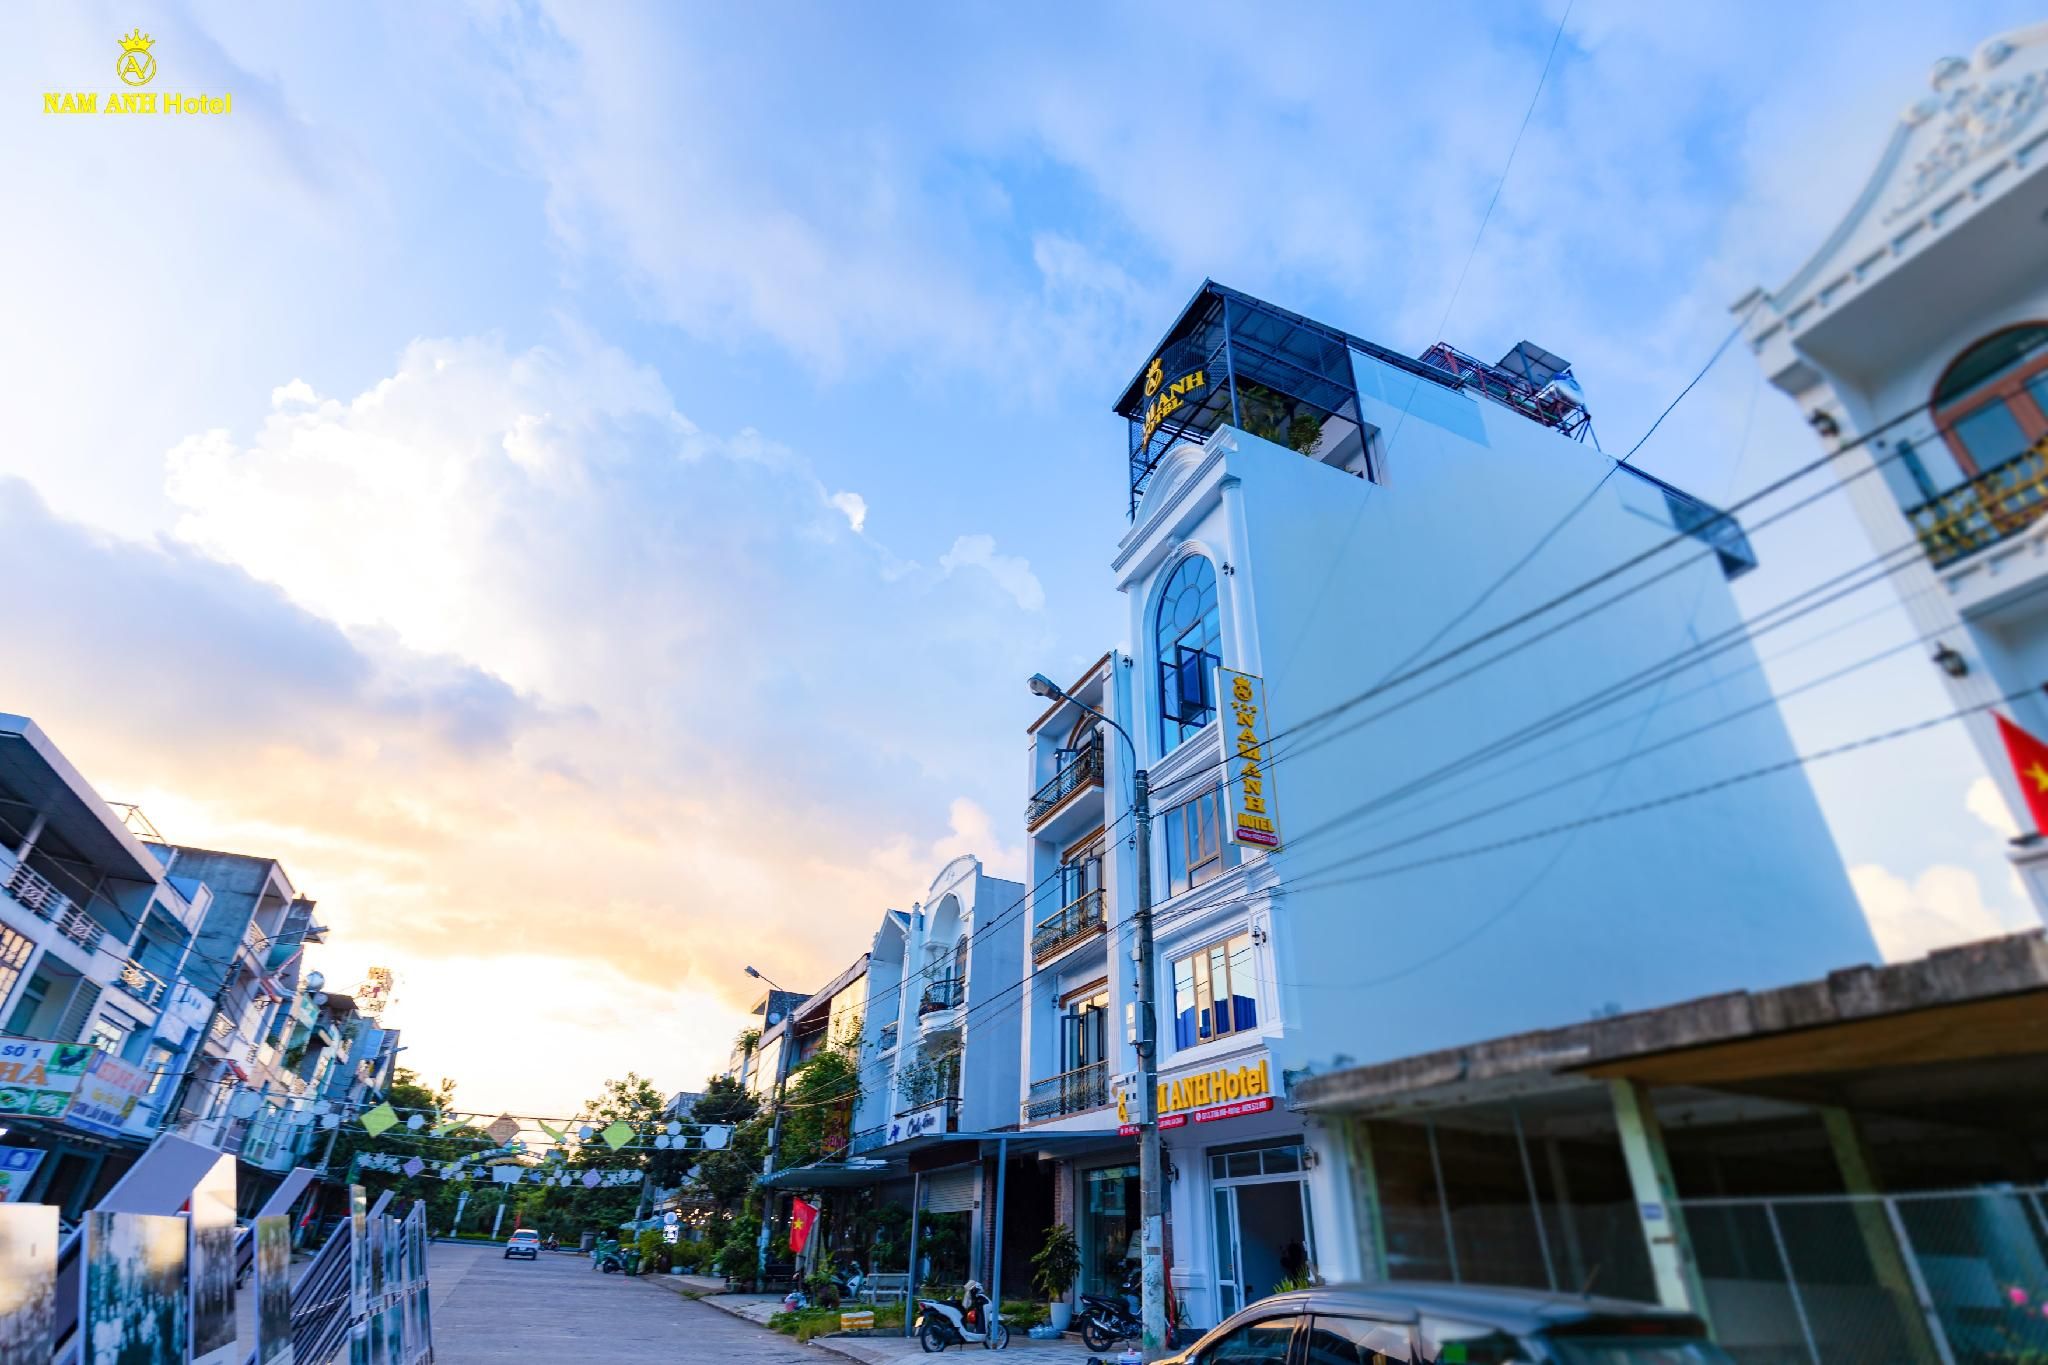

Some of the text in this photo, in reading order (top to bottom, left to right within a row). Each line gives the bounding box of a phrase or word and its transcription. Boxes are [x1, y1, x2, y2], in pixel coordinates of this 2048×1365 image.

[1156, 371, 1206, 410] ANH
[1236, 711, 1261, 761] NAM
[1241, 762, 1266, 813] ANH
[1238, 813, 1275, 832] HOTEL
[32, 1048, 41, 1059] 1
[1170, 1073, 1211, 1112] ANH
[1211, 1059, 1269, 1103] Hotel
